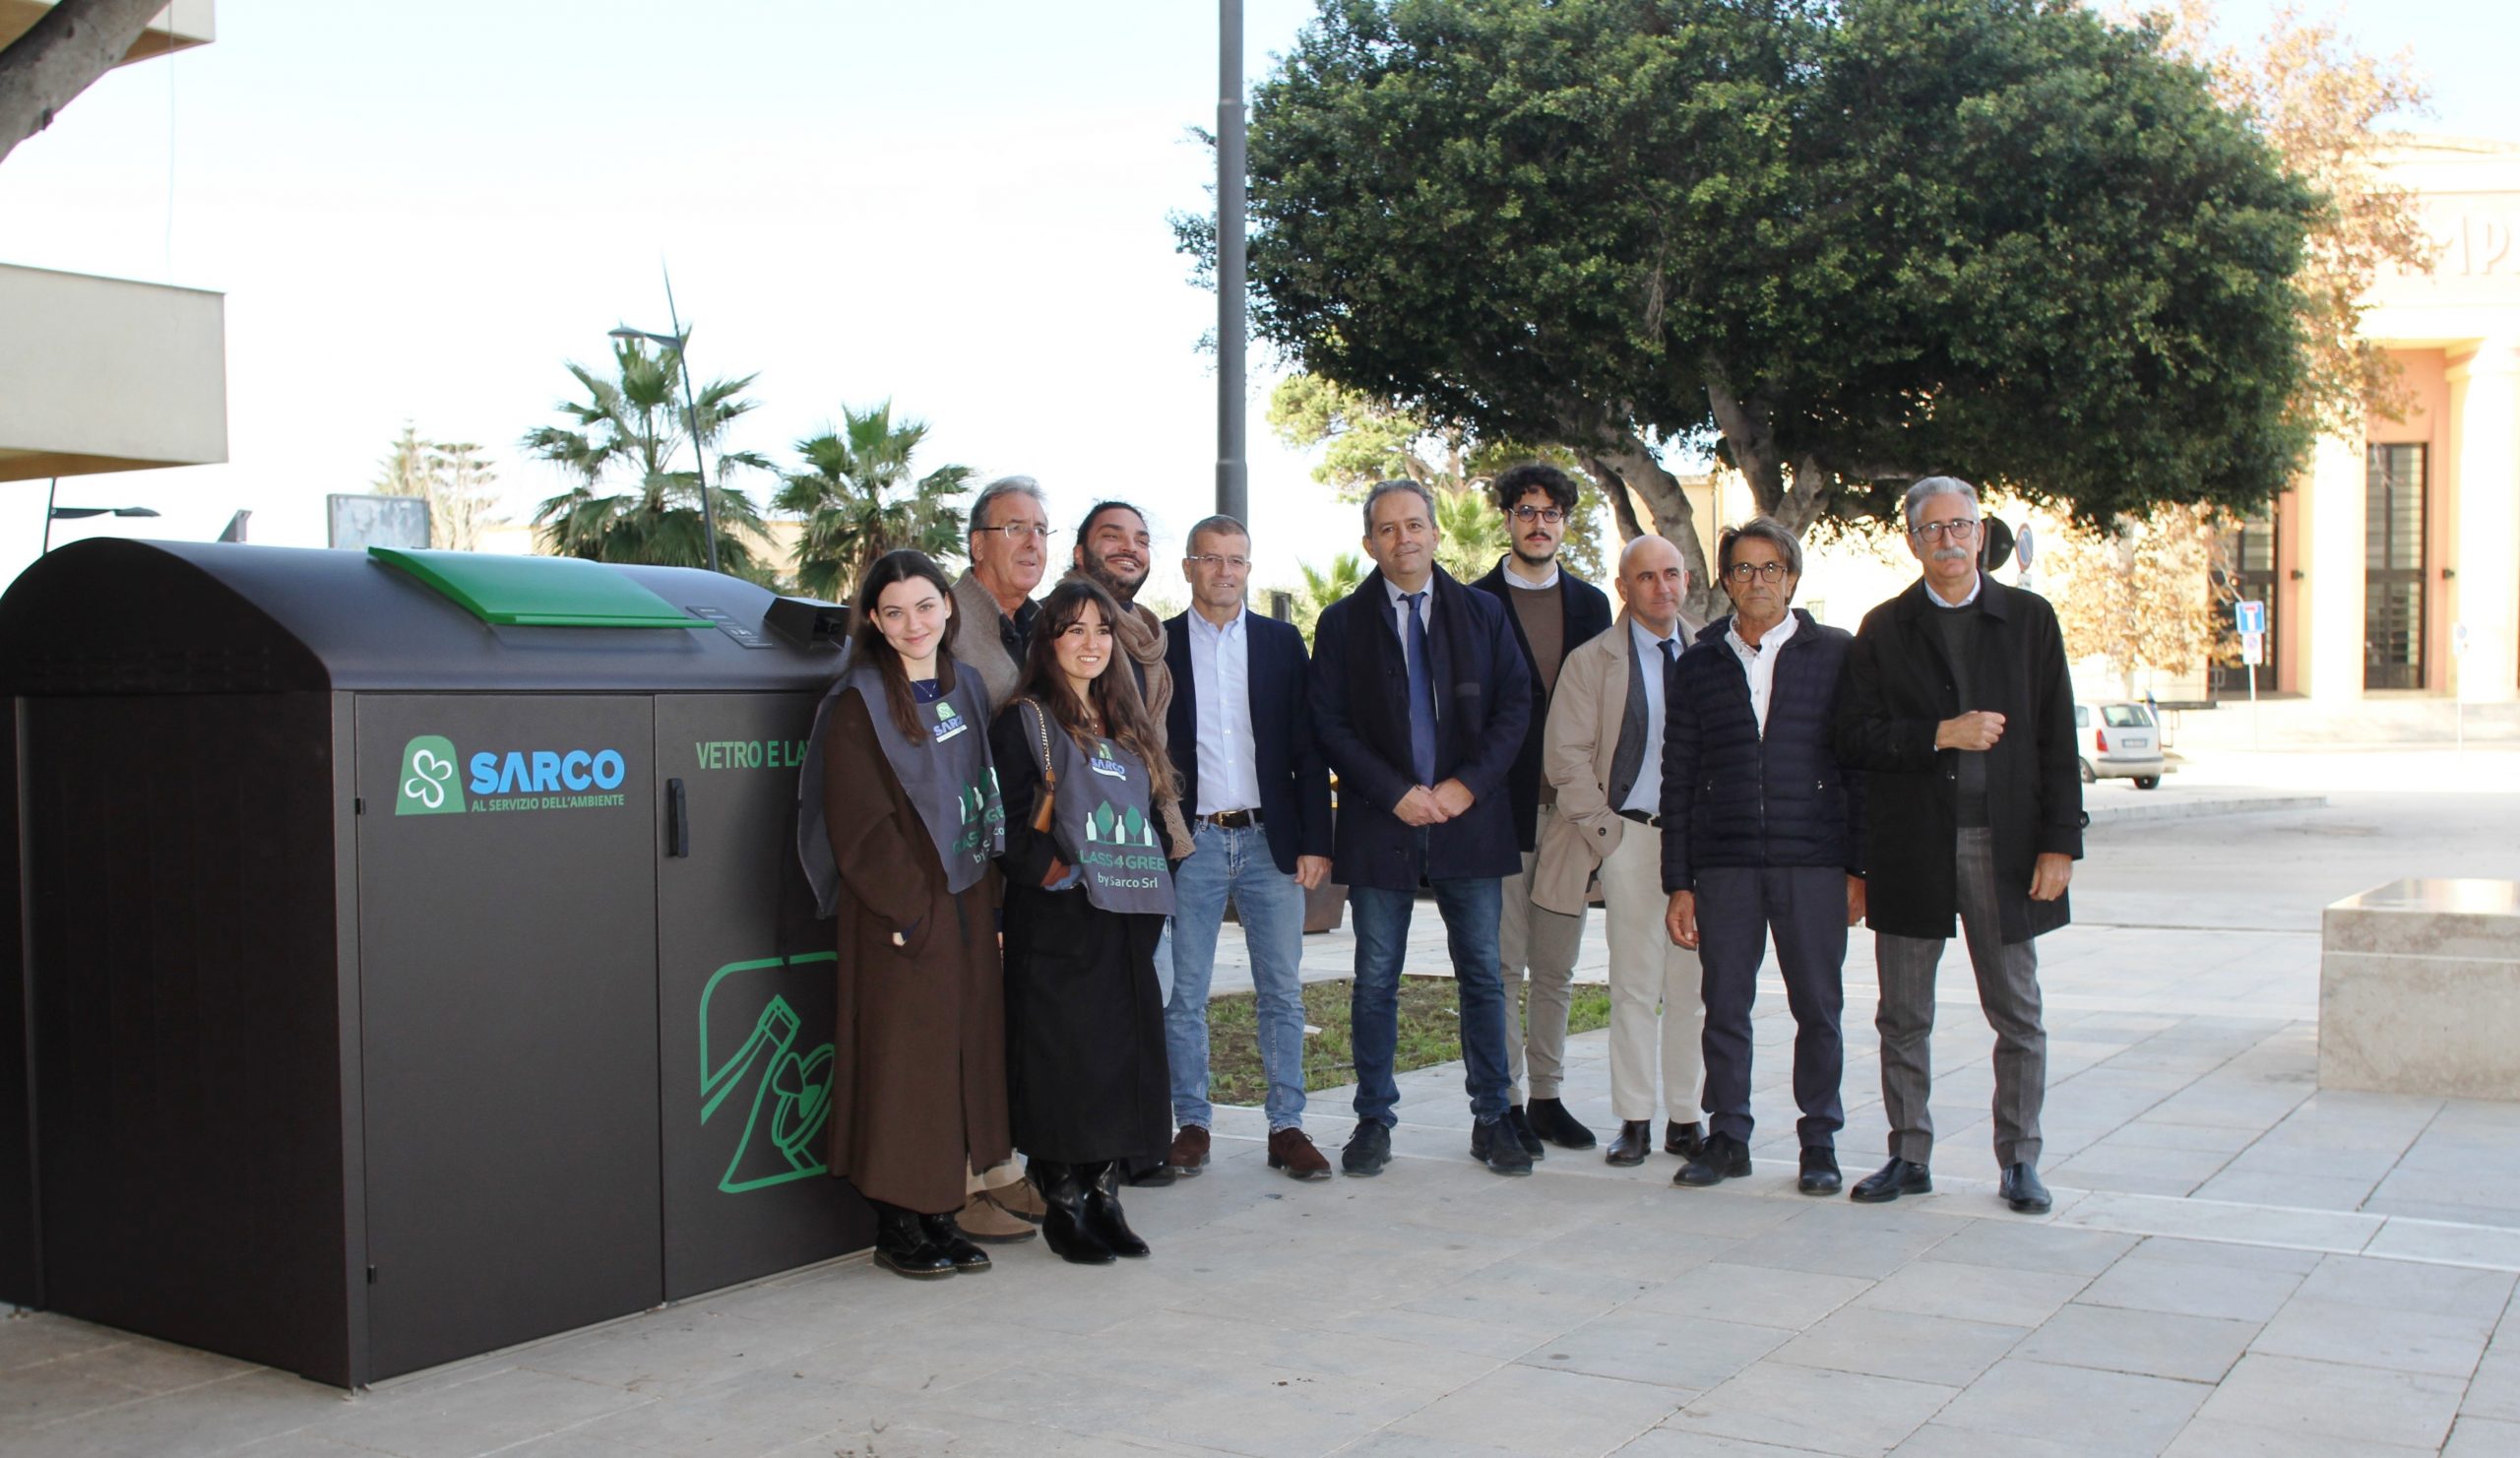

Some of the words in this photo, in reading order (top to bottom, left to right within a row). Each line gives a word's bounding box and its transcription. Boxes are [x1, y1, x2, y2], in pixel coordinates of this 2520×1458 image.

[695, 740, 763, 769] VETRO
[767, 740, 780, 767] E
[784, 740, 809, 767] LA
[470, 749, 625, 794] SARCO
[1090, 757, 1125, 775] SARCO
[472, 799, 486, 812] AL
[488, 797, 539, 811] SERVIZIO
[541, 793, 625, 809] DELL'AMBIENTE
[1098, 871, 1109, 888] by
[1141, 877, 1159, 889] Srl
